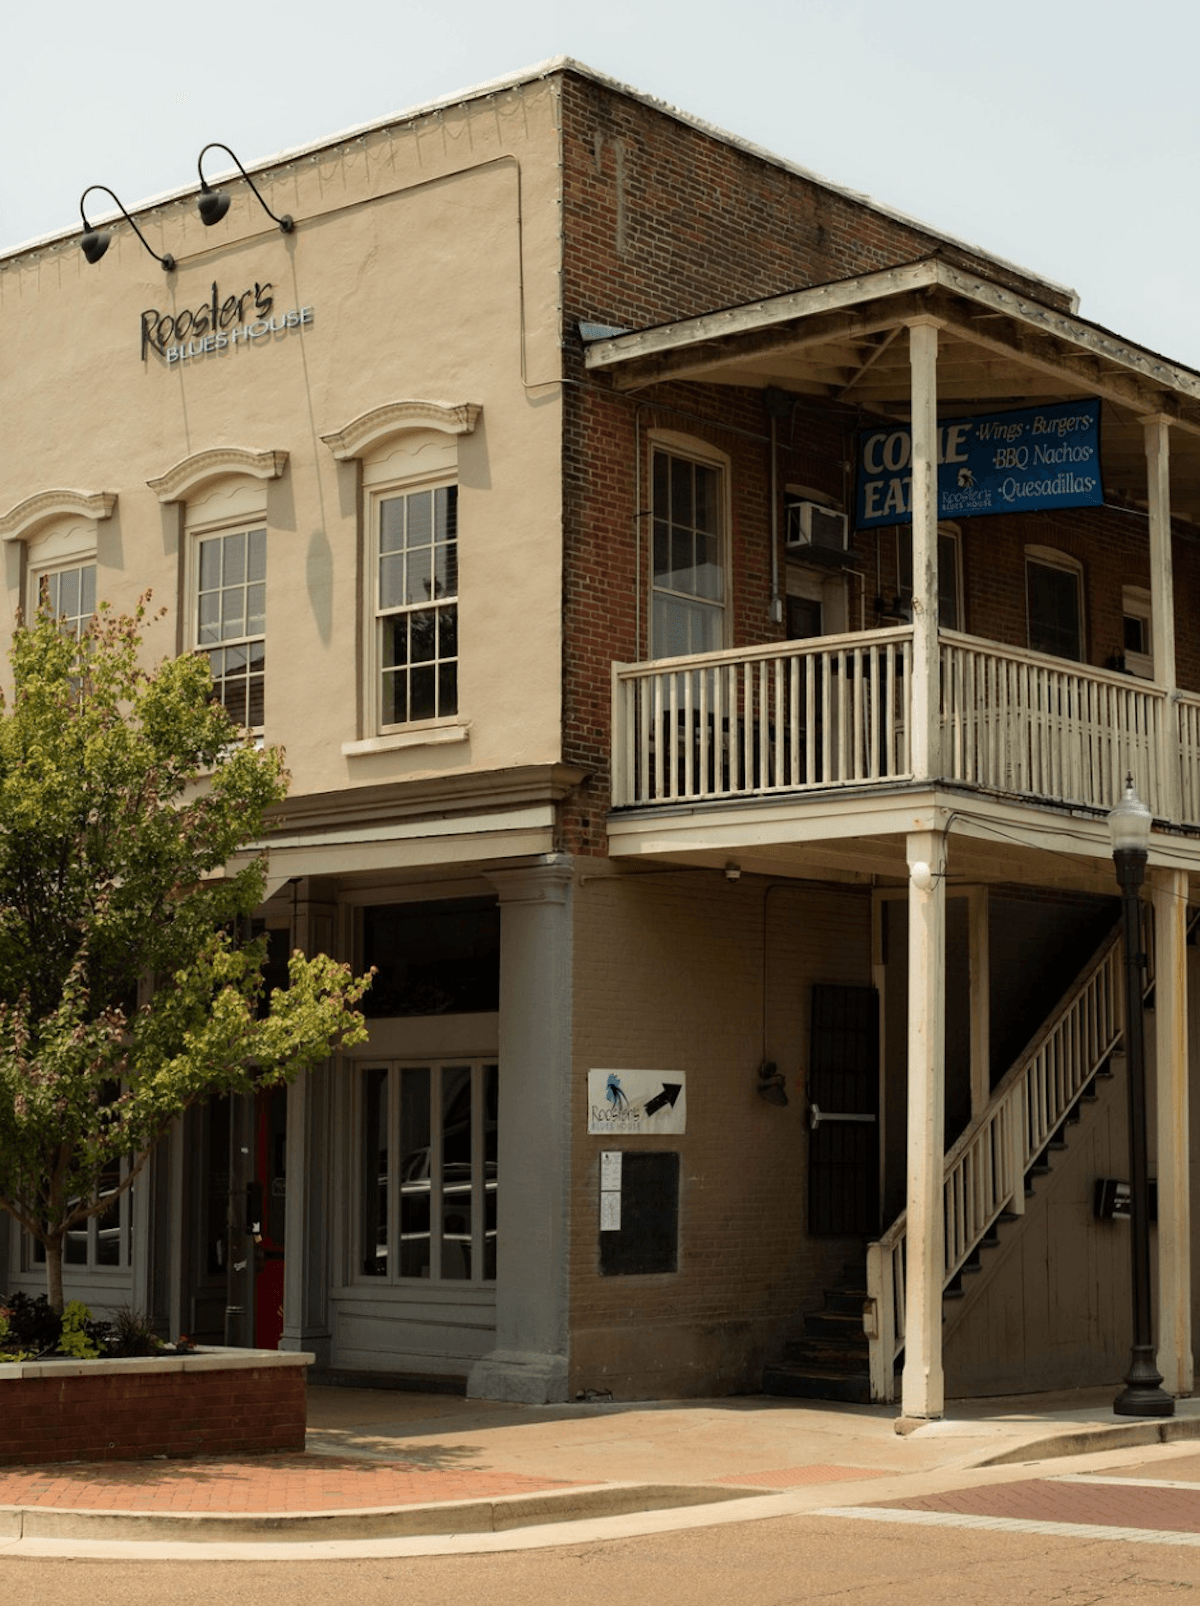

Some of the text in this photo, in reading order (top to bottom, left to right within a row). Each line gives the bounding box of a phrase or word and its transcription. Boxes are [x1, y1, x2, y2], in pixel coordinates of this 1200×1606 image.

[140, 280, 273, 361] Rooster's
[166, 306, 312, 363] BLUES HOUSE
[863, 423, 974, 475] COE
[980, 415, 1090, 442] Wings Burgers
[995, 441, 1090, 470] BBQ Nachos
[1002, 472, 1093, 502] Quesadillas
